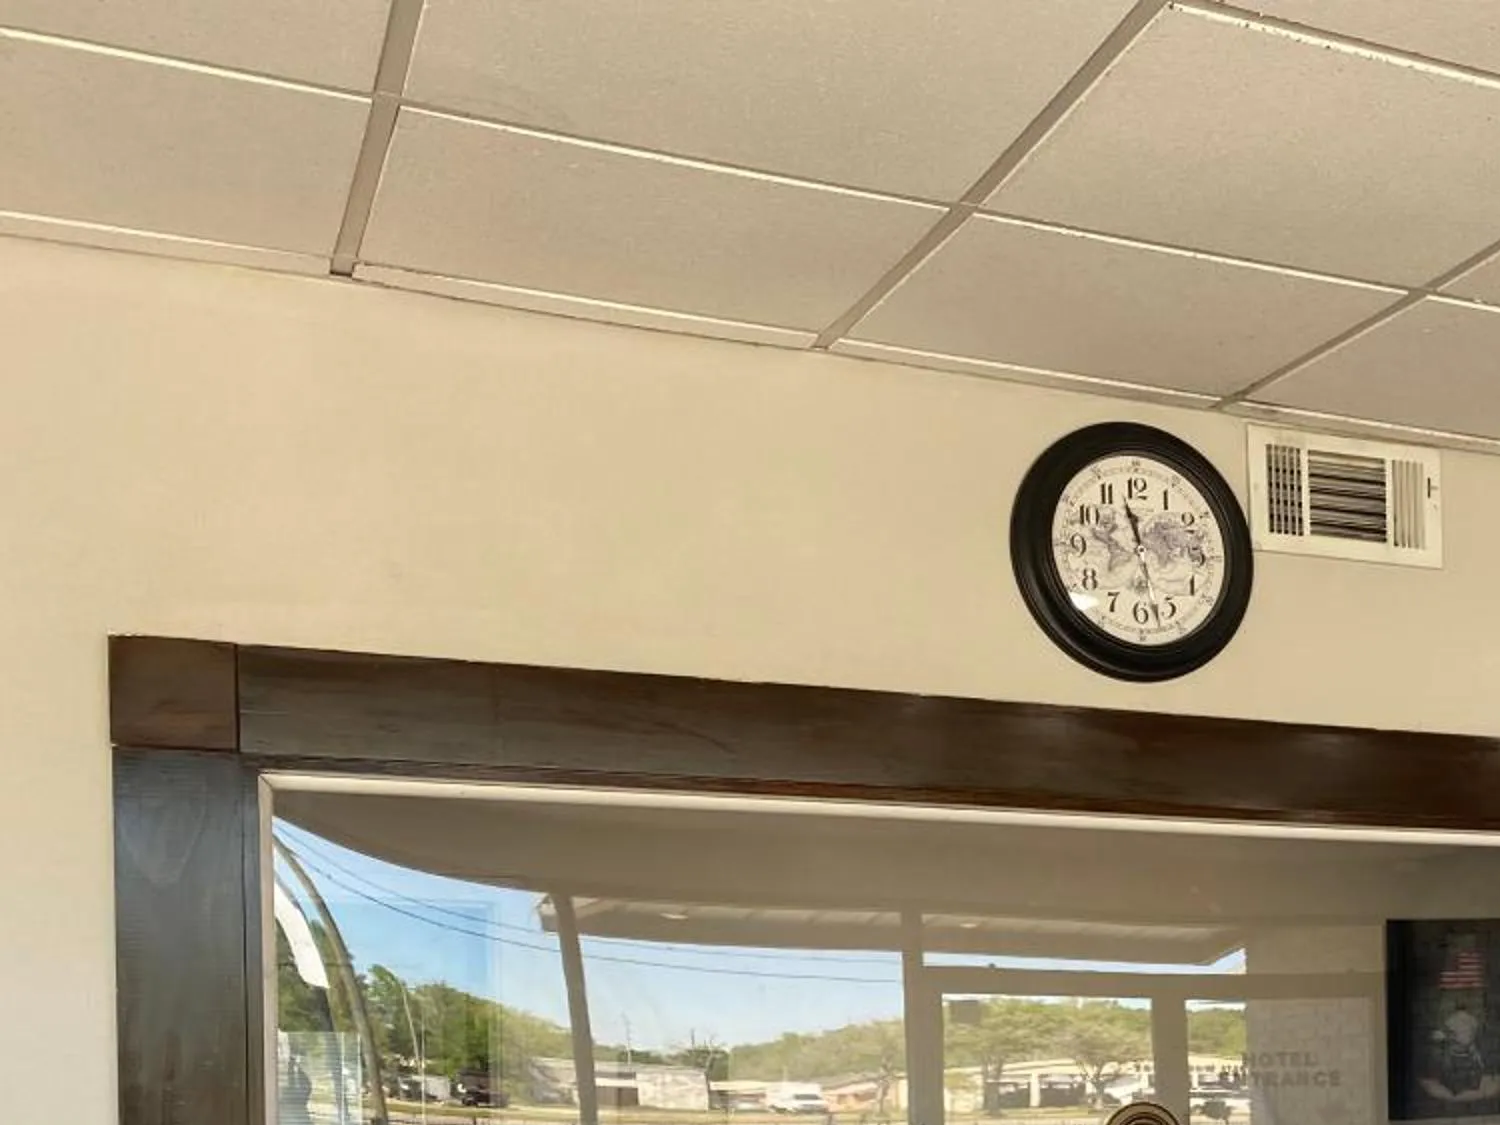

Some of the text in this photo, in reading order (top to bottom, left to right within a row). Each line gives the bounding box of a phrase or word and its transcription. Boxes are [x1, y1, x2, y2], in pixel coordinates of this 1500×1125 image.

[1100, 483, 1113, 504] 11
[1127, 477, 1147, 500] 12
[1163, 489, 1169, 511] 1
[1079, 504, 1100, 525] 10
[1181, 512, 1195, 534] 2
[1070, 533, 1087, 557] 9
[1082, 568, 1097, 590] 8
[1107, 591, 1120, 612] 7
[1132, 601, 1149, 624] 6
[1161, 596, 1177, 618] 5
